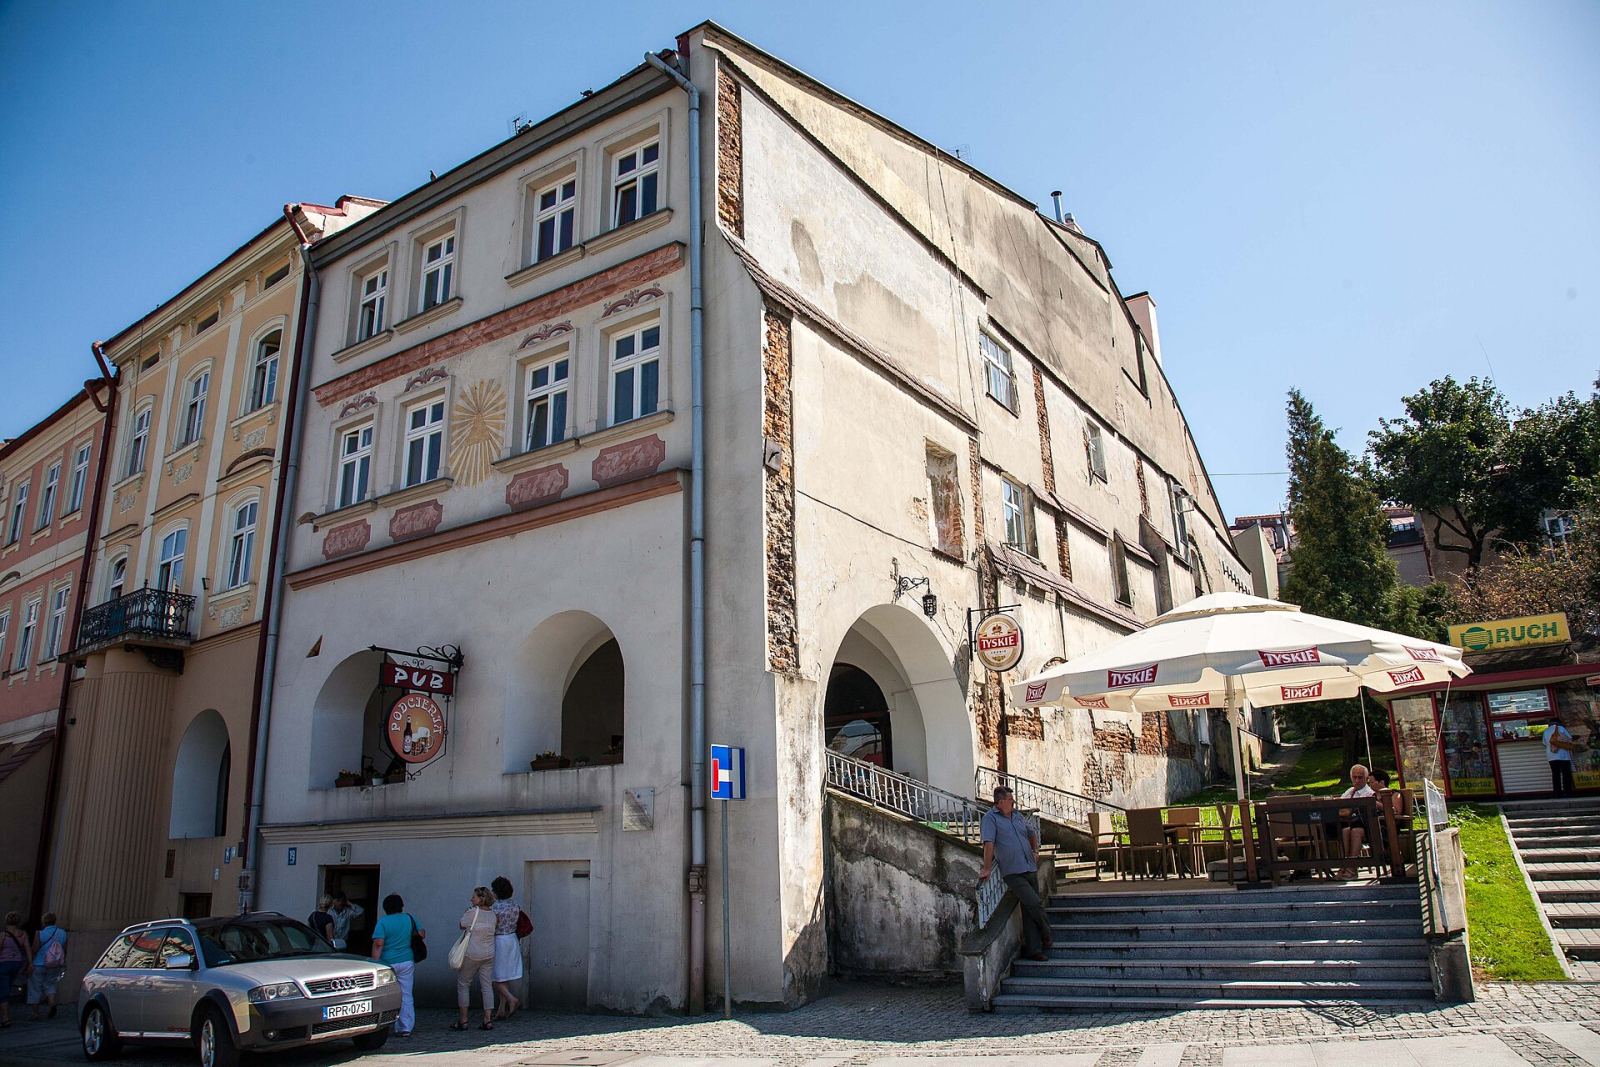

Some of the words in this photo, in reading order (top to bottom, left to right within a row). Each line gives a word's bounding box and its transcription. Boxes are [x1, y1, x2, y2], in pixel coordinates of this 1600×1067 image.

[1496, 622, 1557, 642] RUCH
[981, 636, 1015, 648] TYSKIE
[1264, 650, 1318, 665] TYSKIE
[394, 667, 443, 689] PUB
[1111, 668, 1153, 686] TYSKIE
[328, 1005, 349, 1018] RPR
